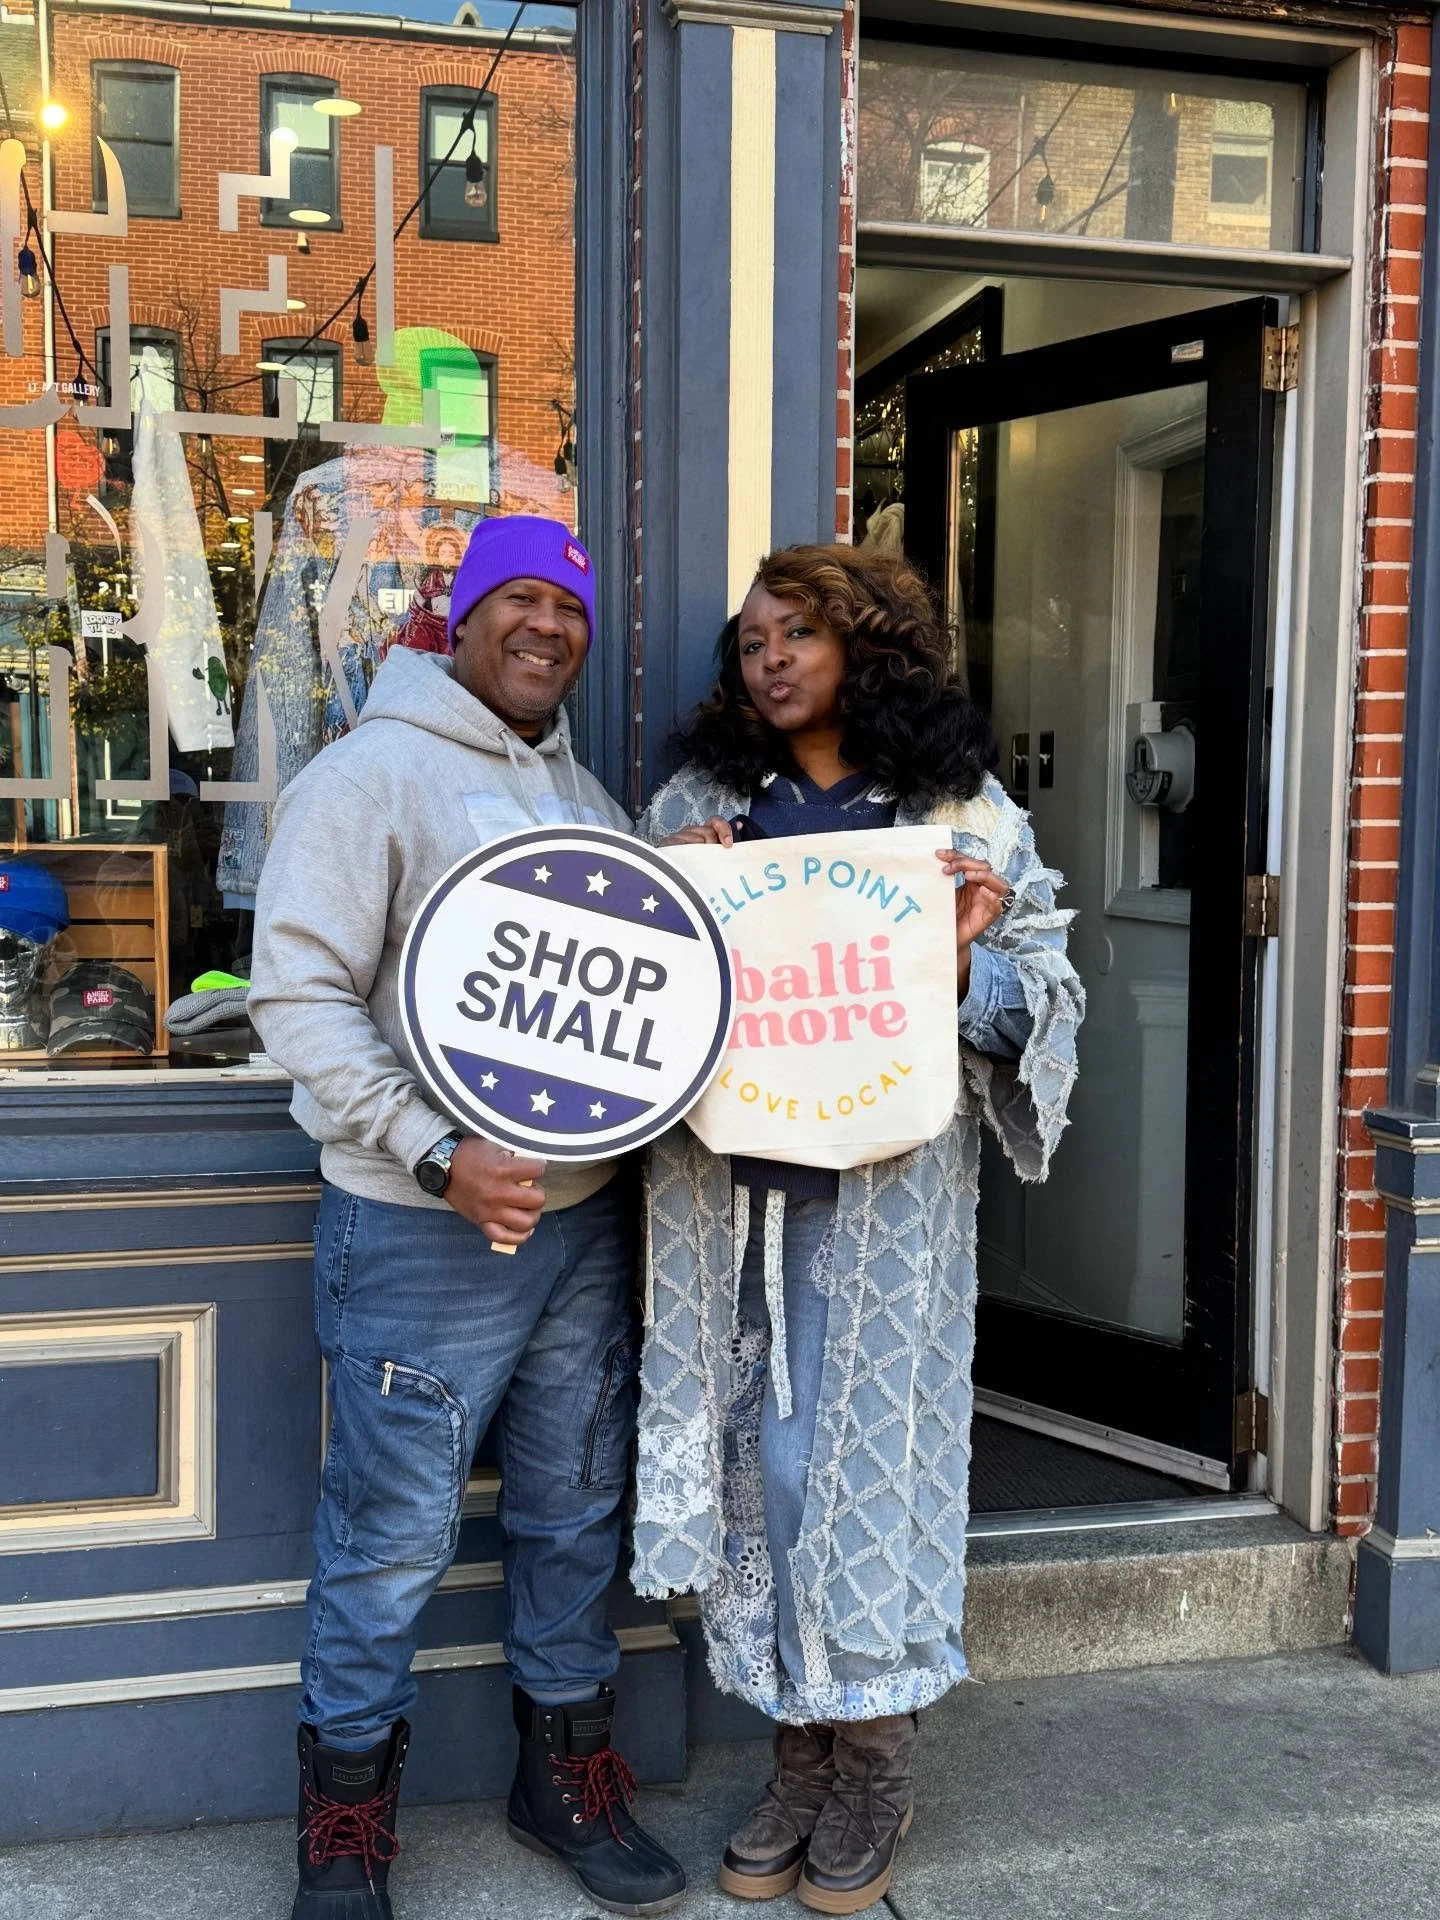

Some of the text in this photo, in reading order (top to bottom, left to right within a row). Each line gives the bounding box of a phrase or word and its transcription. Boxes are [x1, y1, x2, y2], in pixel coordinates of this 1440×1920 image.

[61, 382, 100, 397] GALLERY
[803, 857, 922, 924] POINT
[487, 920, 668, 1005] SHOP
[731, 935, 896, 1004] balti
[456, 970, 663, 1072] SMALL
[727, 1001, 908, 1050] more
[719, 1061, 912, 1121] LOVE LOCAL
